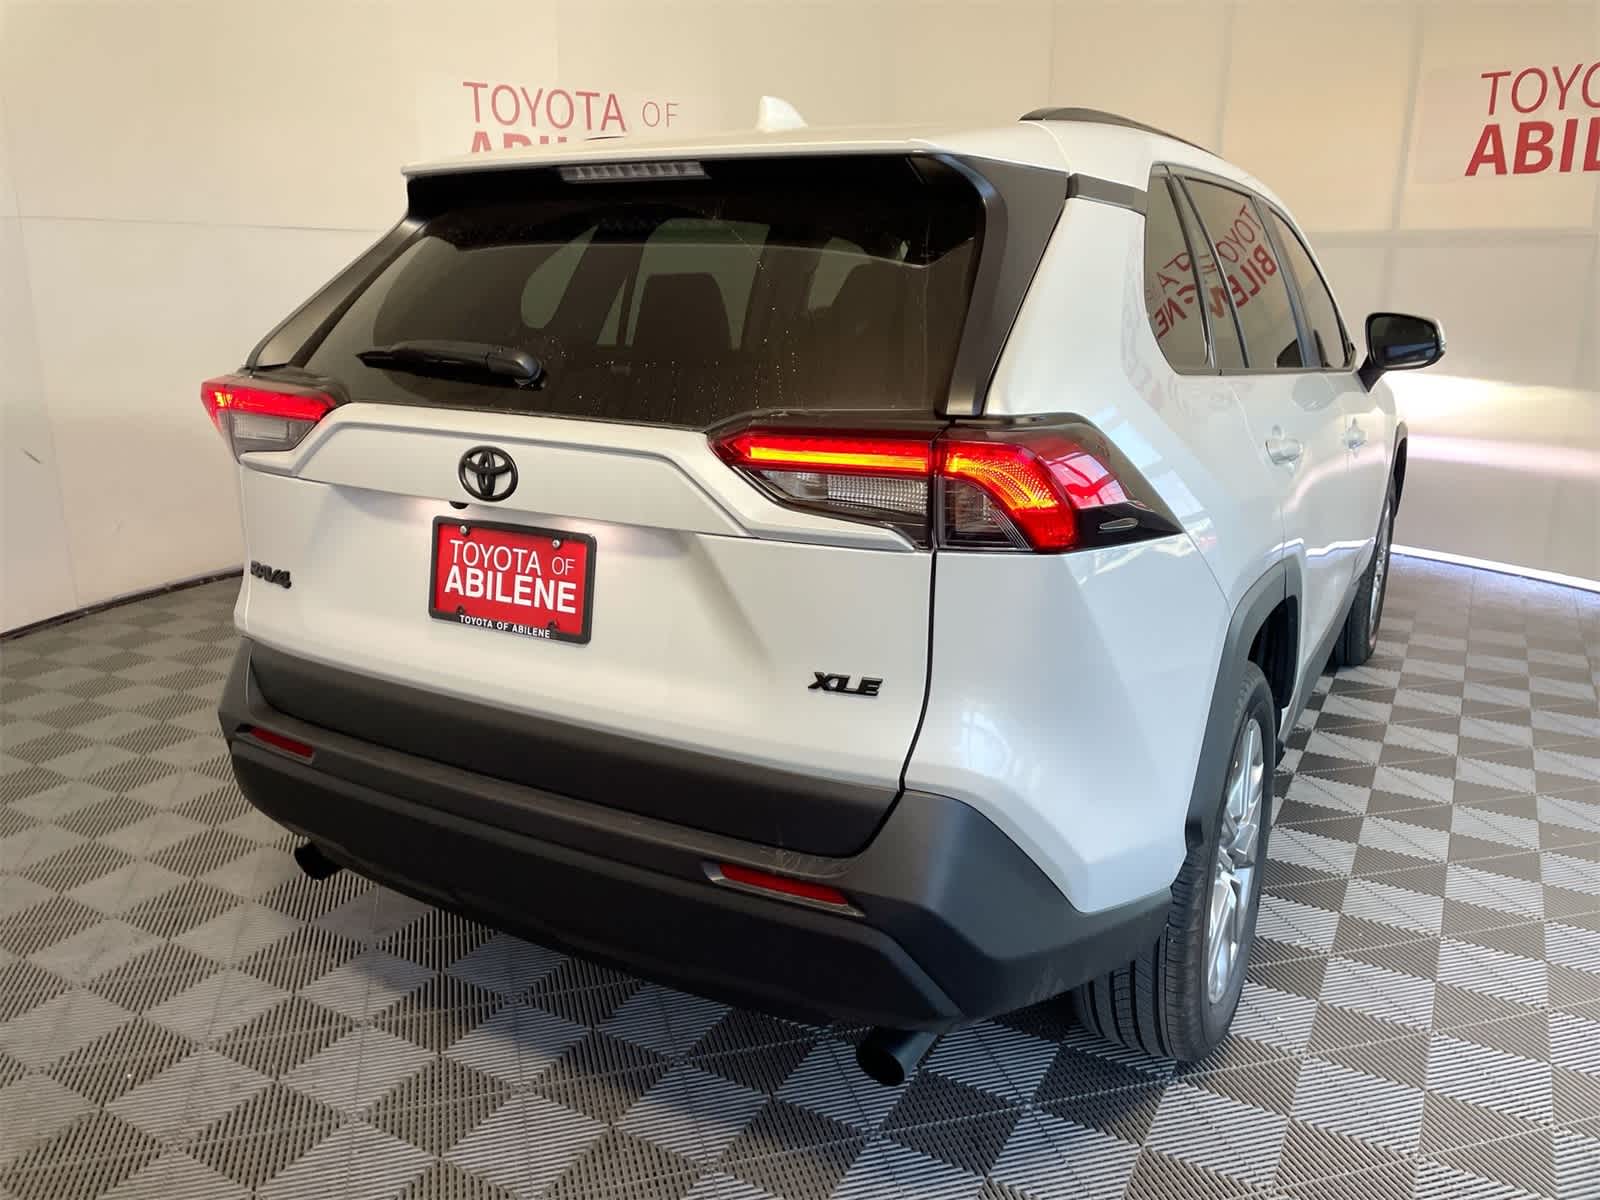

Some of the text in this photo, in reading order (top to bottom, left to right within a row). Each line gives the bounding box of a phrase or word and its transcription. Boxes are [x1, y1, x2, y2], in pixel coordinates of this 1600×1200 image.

[463, 81, 680, 132] TOYOTA OF
[449, 539, 576, 576] TOYOTA OF
[444, 565, 577, 614] ABILENE
[459, 614, 551, 639] TOYOTA OF ABILENE
[807, 671, 884, 697] XLE
